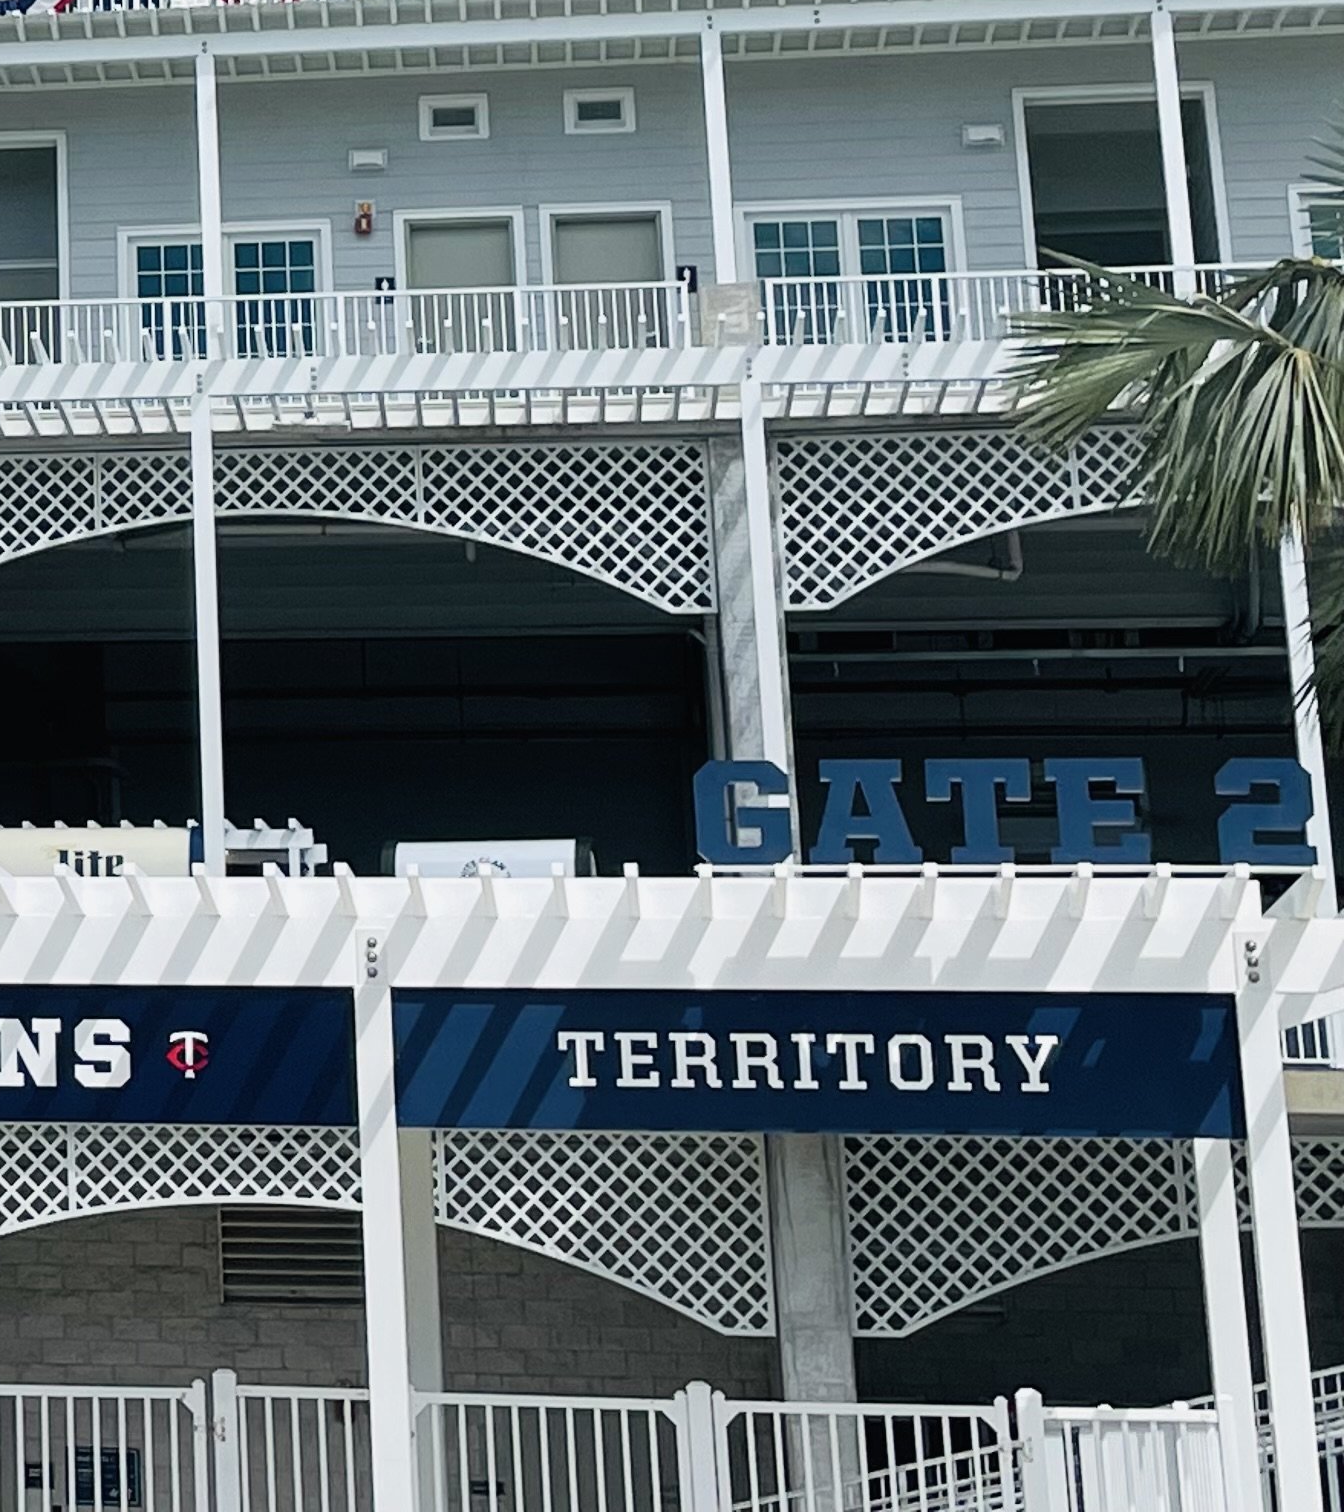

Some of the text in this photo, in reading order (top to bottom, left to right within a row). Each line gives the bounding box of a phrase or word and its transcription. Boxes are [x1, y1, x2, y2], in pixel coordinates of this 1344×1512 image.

[693, 758, 1318, 865] GATE 2
[557, 1030, 1060, 1093] TERRITORY
